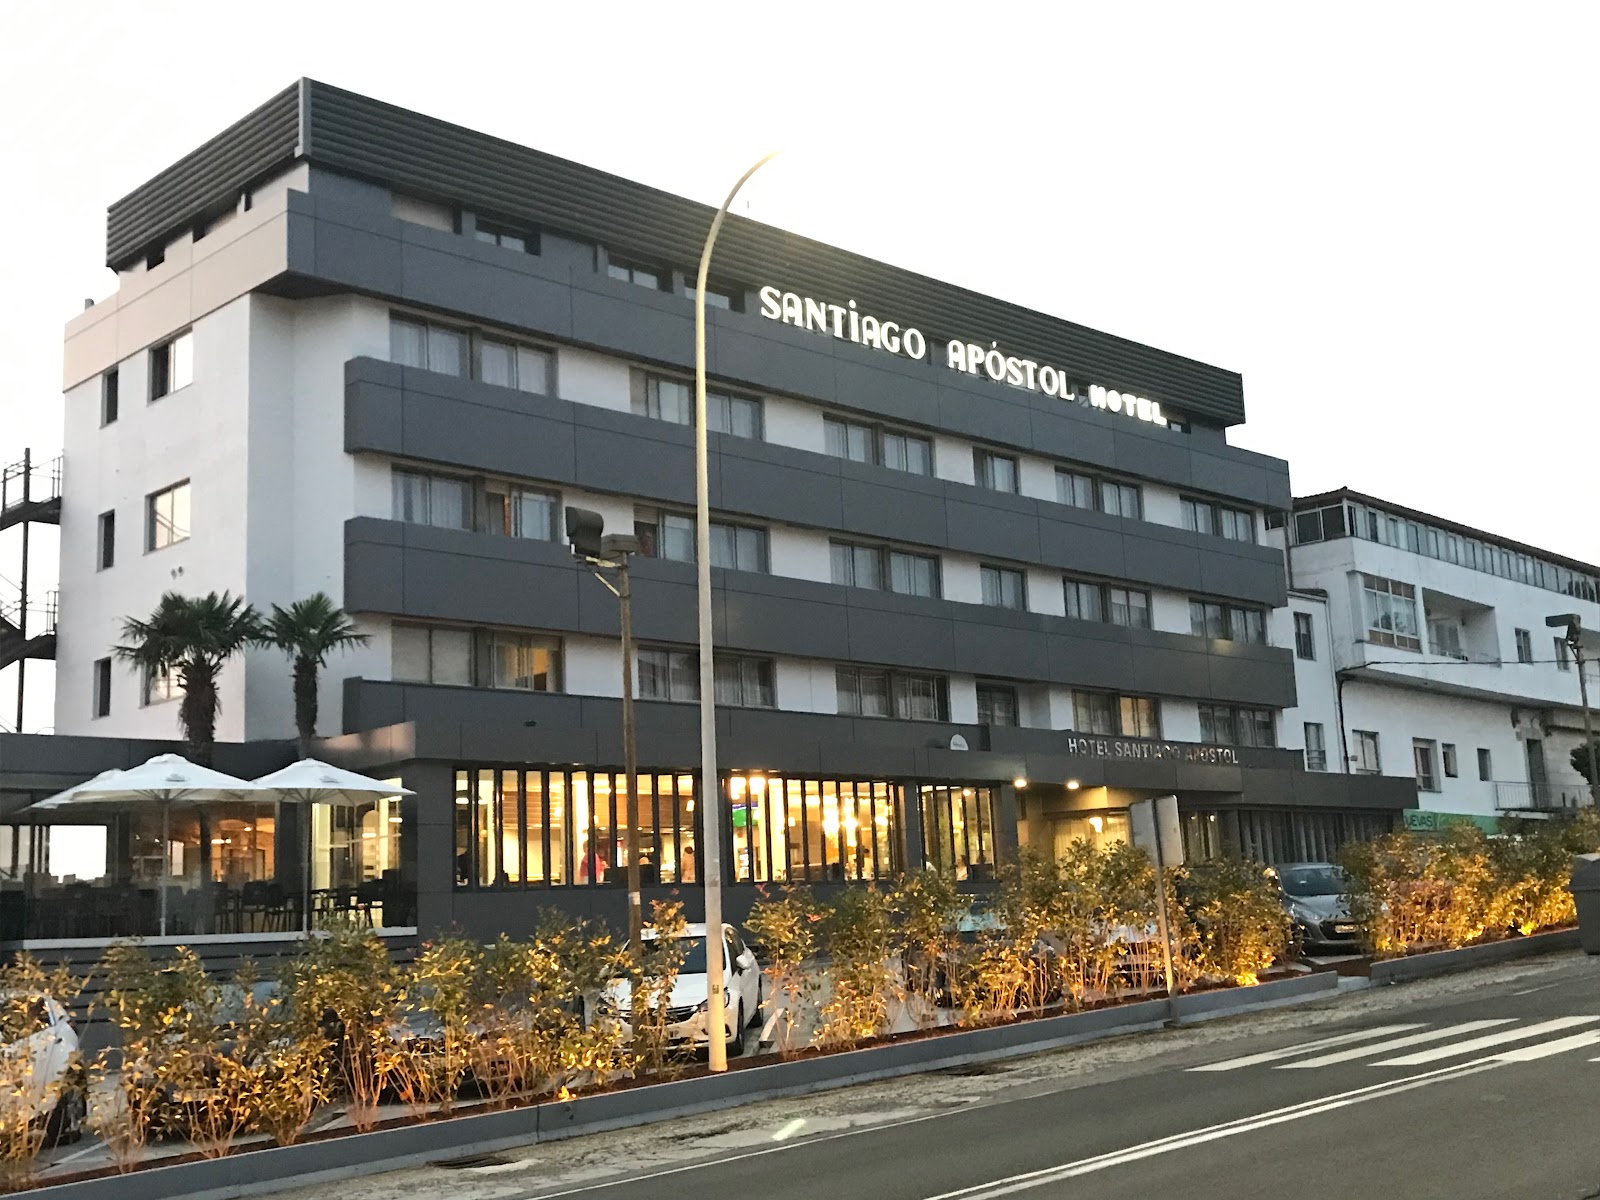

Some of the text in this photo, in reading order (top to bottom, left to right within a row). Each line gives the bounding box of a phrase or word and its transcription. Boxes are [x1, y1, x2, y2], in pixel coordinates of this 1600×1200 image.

[947, 339, 1075, 401] APÓSTOL
[1088, 384, 1168, 426] HOTEL
[1068, 738, 1111, 755] HOTEL
[1115, 742, 1180, 759] SANTIAGO
